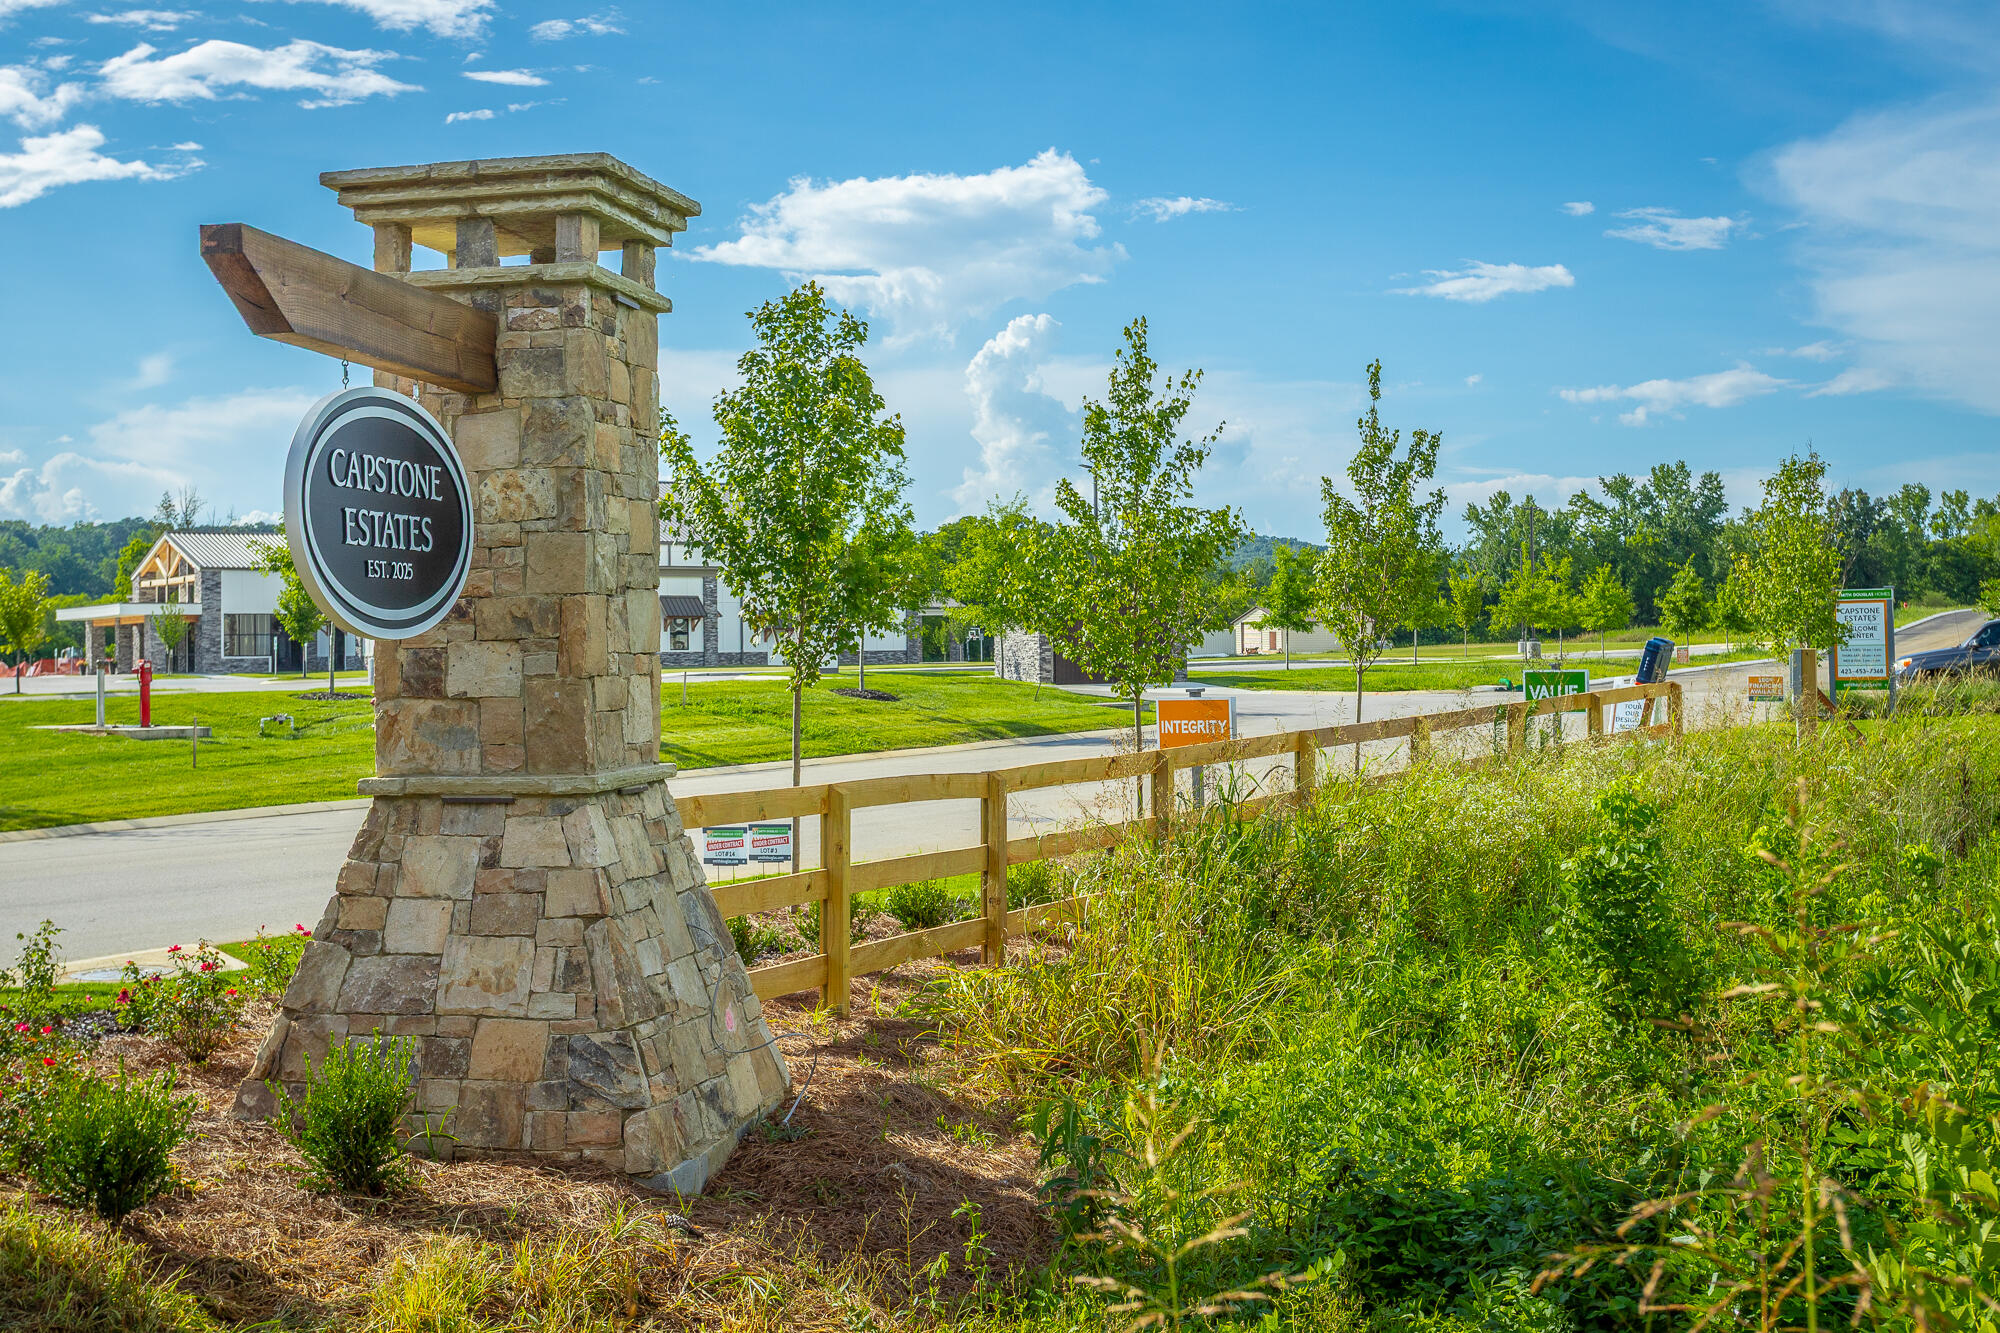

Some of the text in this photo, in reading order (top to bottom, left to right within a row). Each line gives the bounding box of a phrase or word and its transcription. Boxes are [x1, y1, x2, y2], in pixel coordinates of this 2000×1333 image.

[330, 448, 443, 502] CAPSTONE
[344, 507, 433, 552] ESTATES
[367, 559, 414, 580] EST. 2025
[1161, 719, 1227, 734] INTEGRITY
[707, 842, 722, 850] UNDER
[722, 840, 743, 849] CONTRACT
[768, 837, 788, 846] CONTRACT
